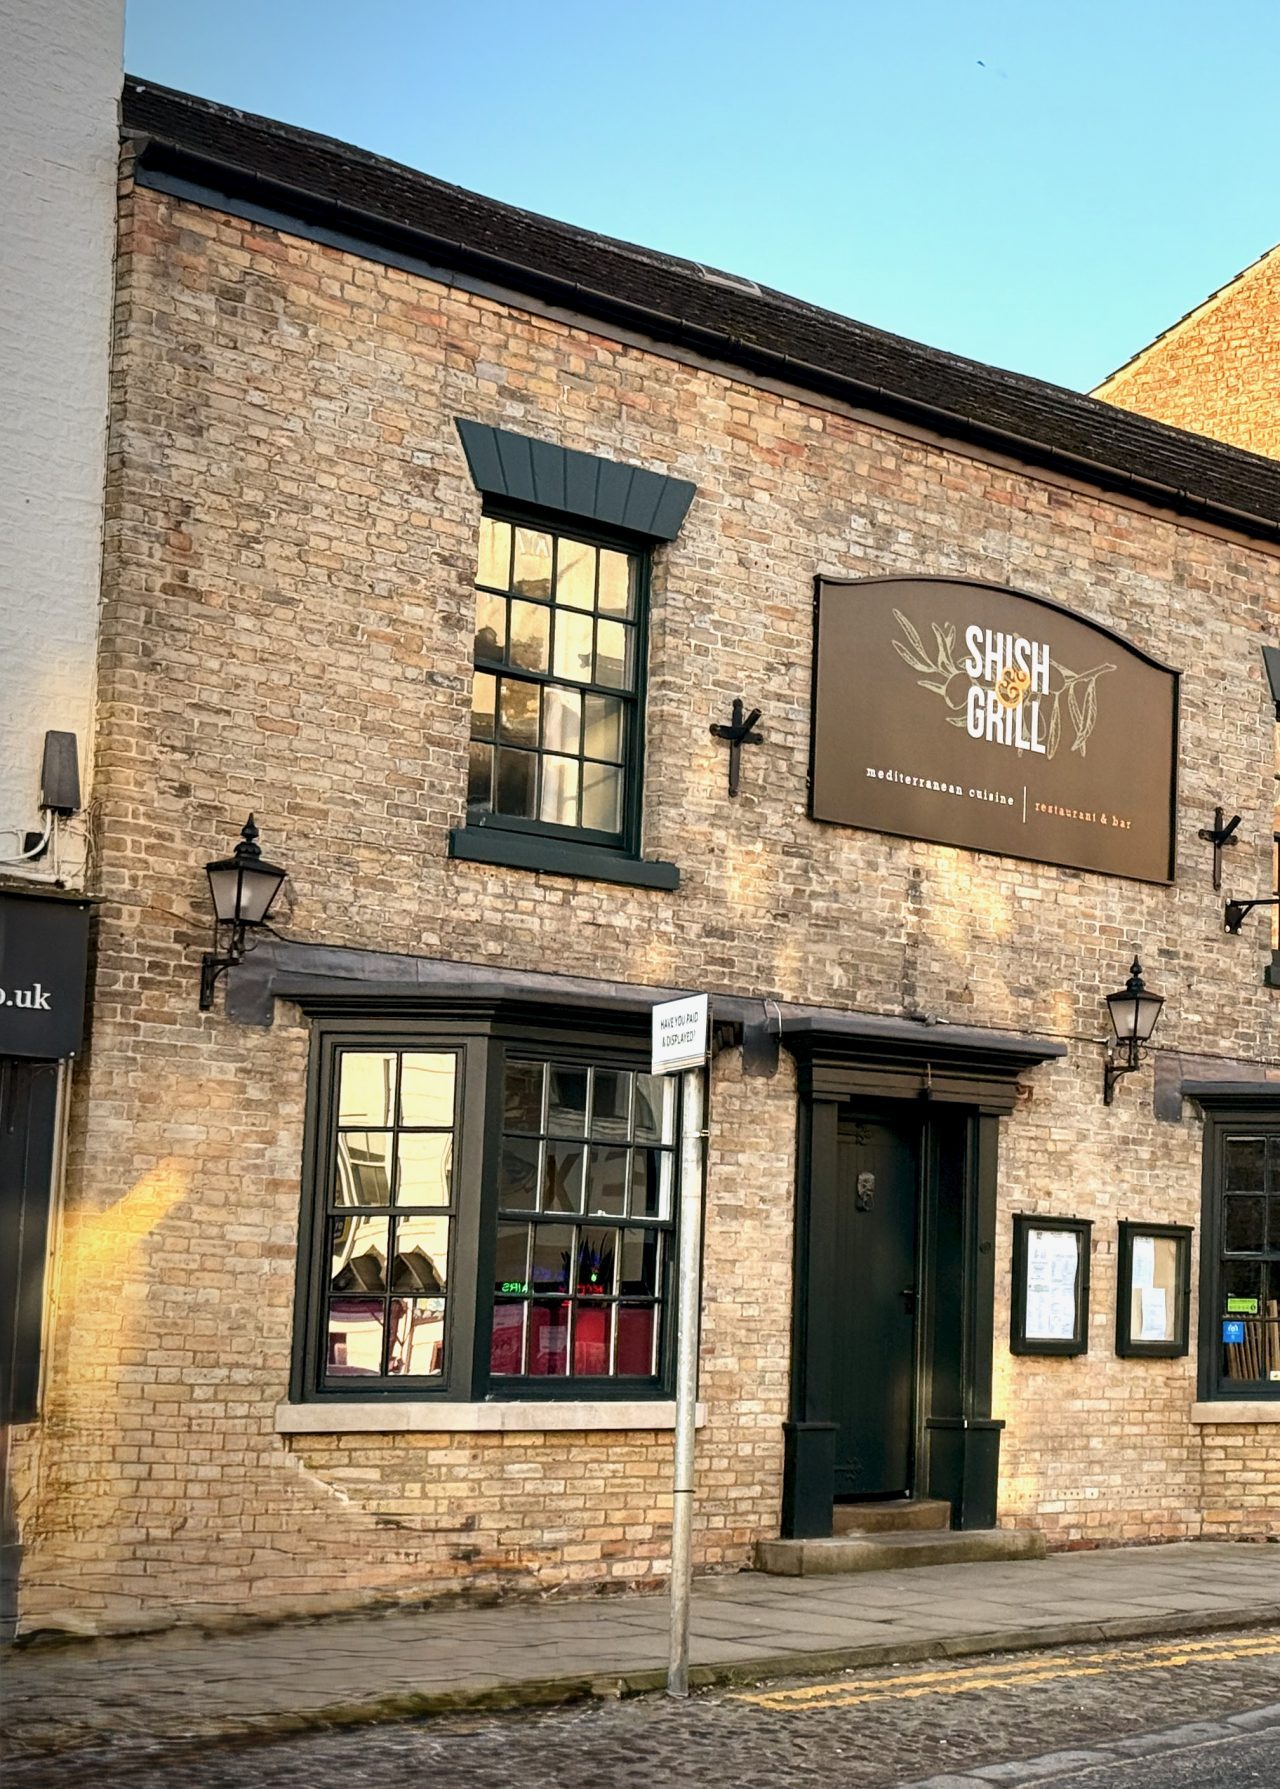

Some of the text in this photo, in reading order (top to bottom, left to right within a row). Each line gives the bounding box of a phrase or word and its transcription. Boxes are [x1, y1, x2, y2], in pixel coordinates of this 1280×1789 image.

[965, 625, 1050, 695] SHISH
[994, 666, 1032, 709] &
[966, 685, 1047, 754] GRILL
[866, 766, 1016, 806] mediterranean cuisine
[1034, 800, 1132, 830] restaurant & bar
[661, 1011, 698, 1030] HAVE YOU PAID
